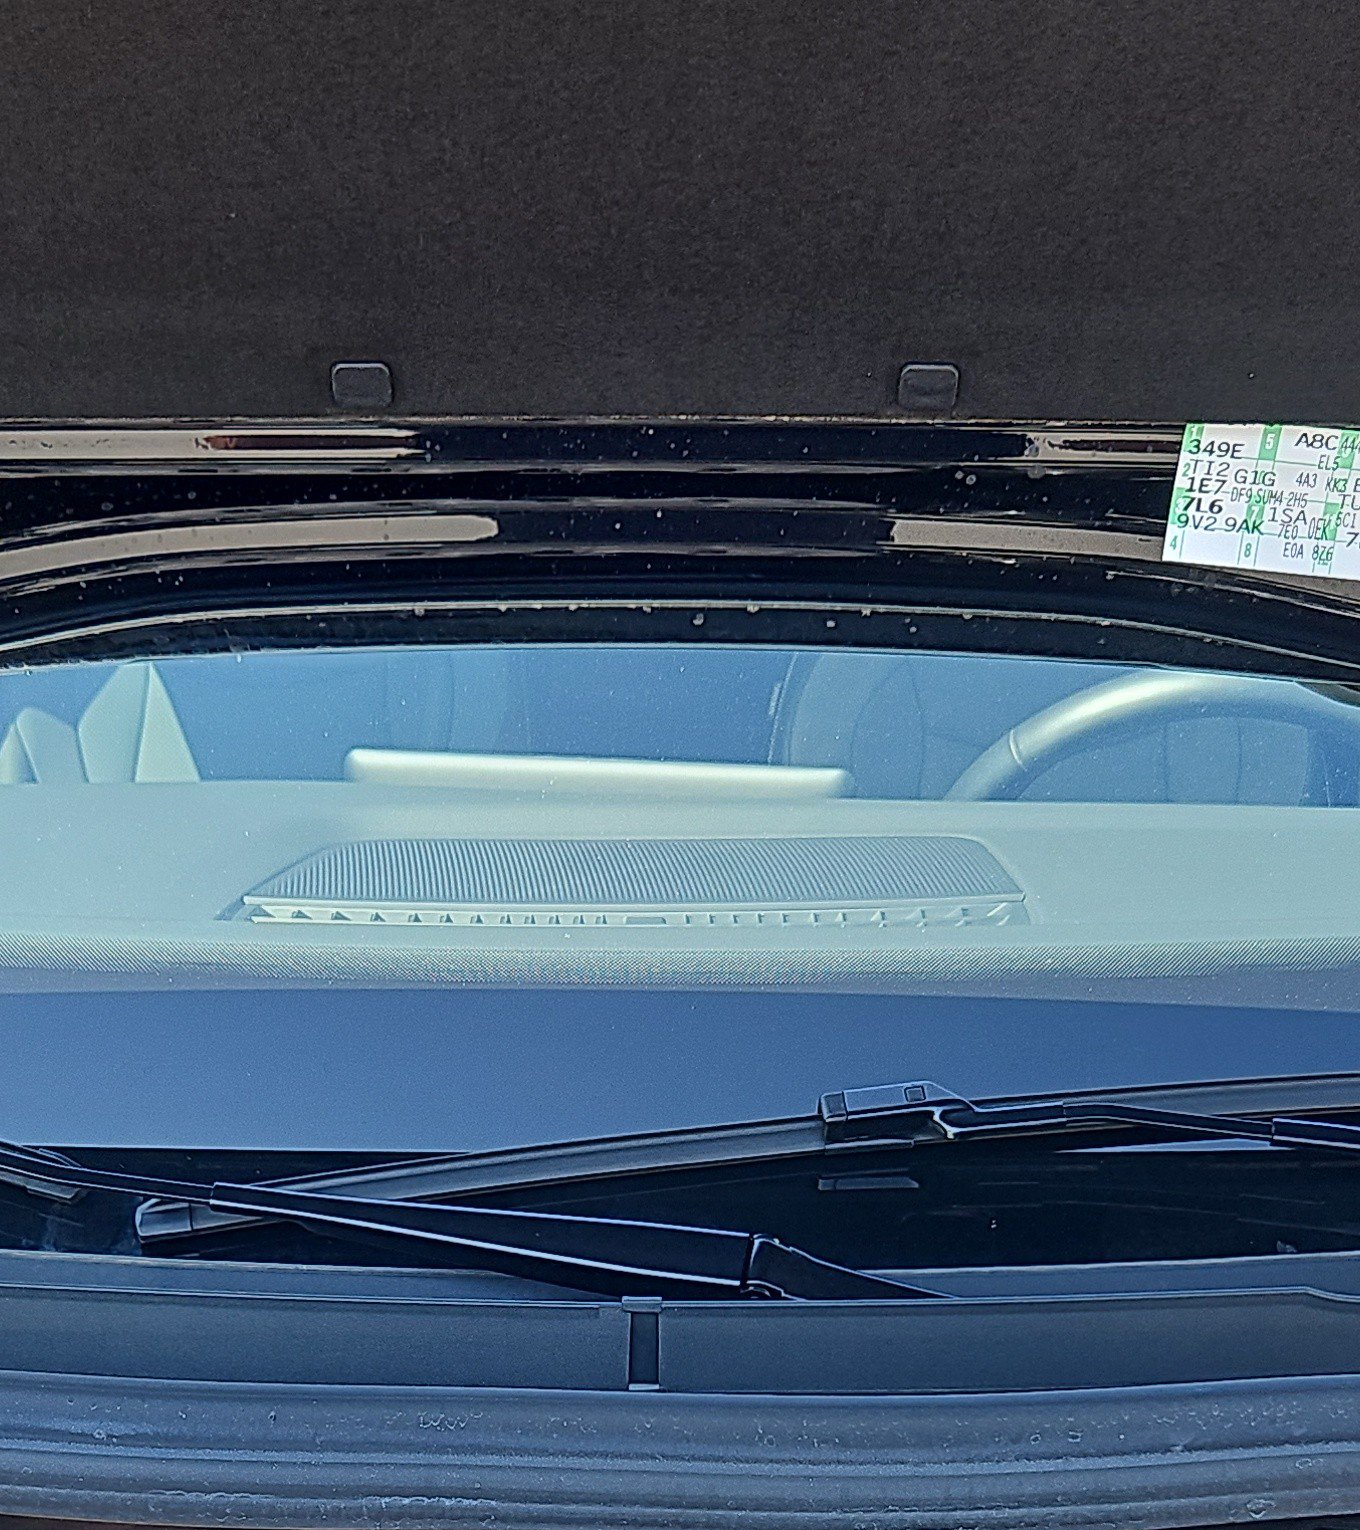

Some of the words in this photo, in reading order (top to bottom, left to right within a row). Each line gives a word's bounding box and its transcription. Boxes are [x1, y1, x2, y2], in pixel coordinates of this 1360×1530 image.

[1188, 439, 1245, 459] 349E
[1185, 476, 1227, 495] 1E7
[1296, 472, 1317, 488] 4A3
[1181, 496, 1224, 514] 7L6
[1268, 507, 1307, 525] 1SA
[1225, 517, 1264, 535] 9AK
[1244, 542, 1252, 558] 8
